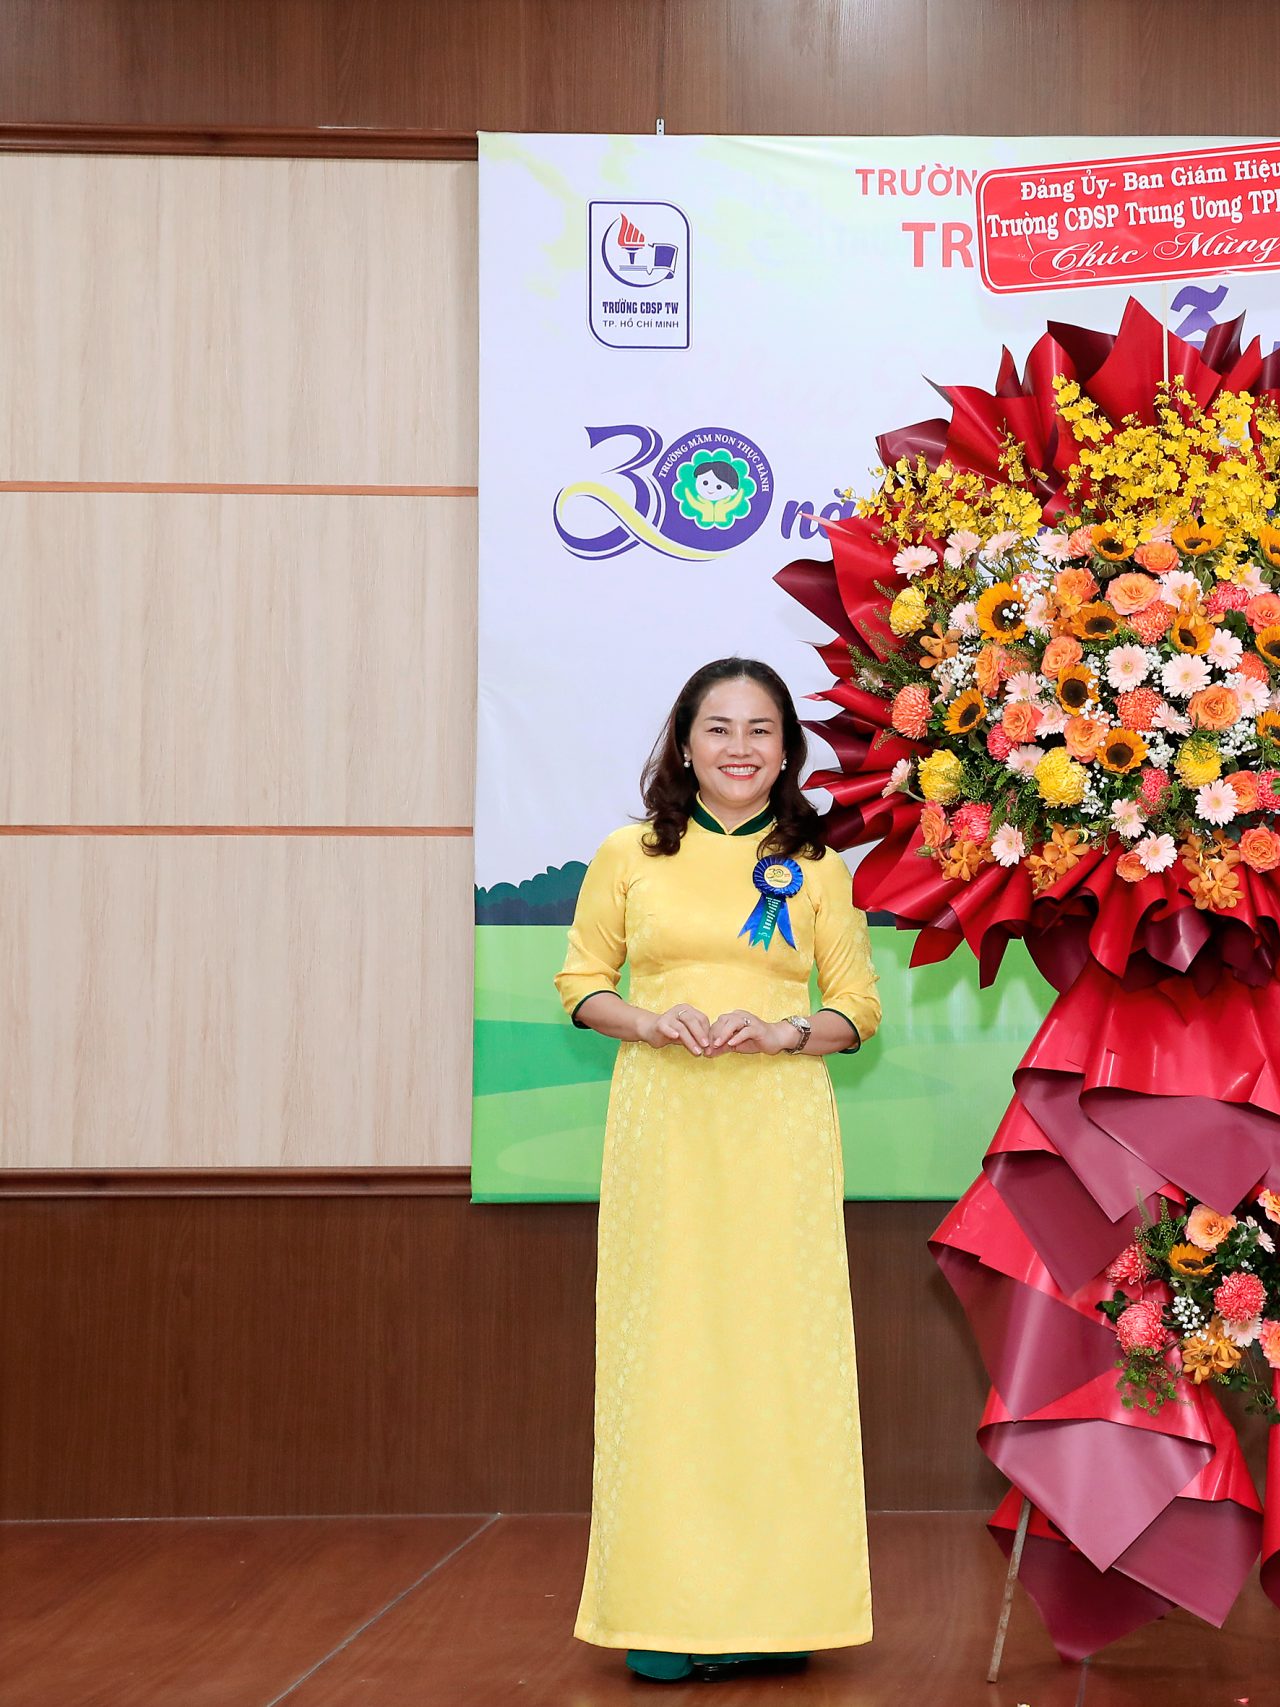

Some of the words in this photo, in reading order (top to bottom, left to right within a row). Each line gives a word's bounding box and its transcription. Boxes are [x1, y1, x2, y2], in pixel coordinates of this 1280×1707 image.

[855, 163, 977, 196] TRƯỜN
[1021, 178, 1075, 203] Đảng
[1123, 172, 1165, 191] Ban
[1171, 165, 1228, 185] Giám
[986, 211, 1059, 240] Trường
[1064, 204, 1119, 231] CĐSP
[1124, 200, 1186, 228] Trung
[1190, 195, 1243, 223] Ương
[902, 222, 974, 268] TR
[1029, 241, 1148, 279] Chúc
[603, 320, 617, 328] TP.
[636, 318, 653, 328] CHÍ
[655, 320, 679, 328] MINH
[640, 301, 662, 314] CĐSP
[665, 302, 679, 314] TW
[714, 433, 737, 446] NON
[737, 440, 761, 463] THỰC
[756, 462, 770, 492] HÀNH
[780, 488, 857, 539] nă
